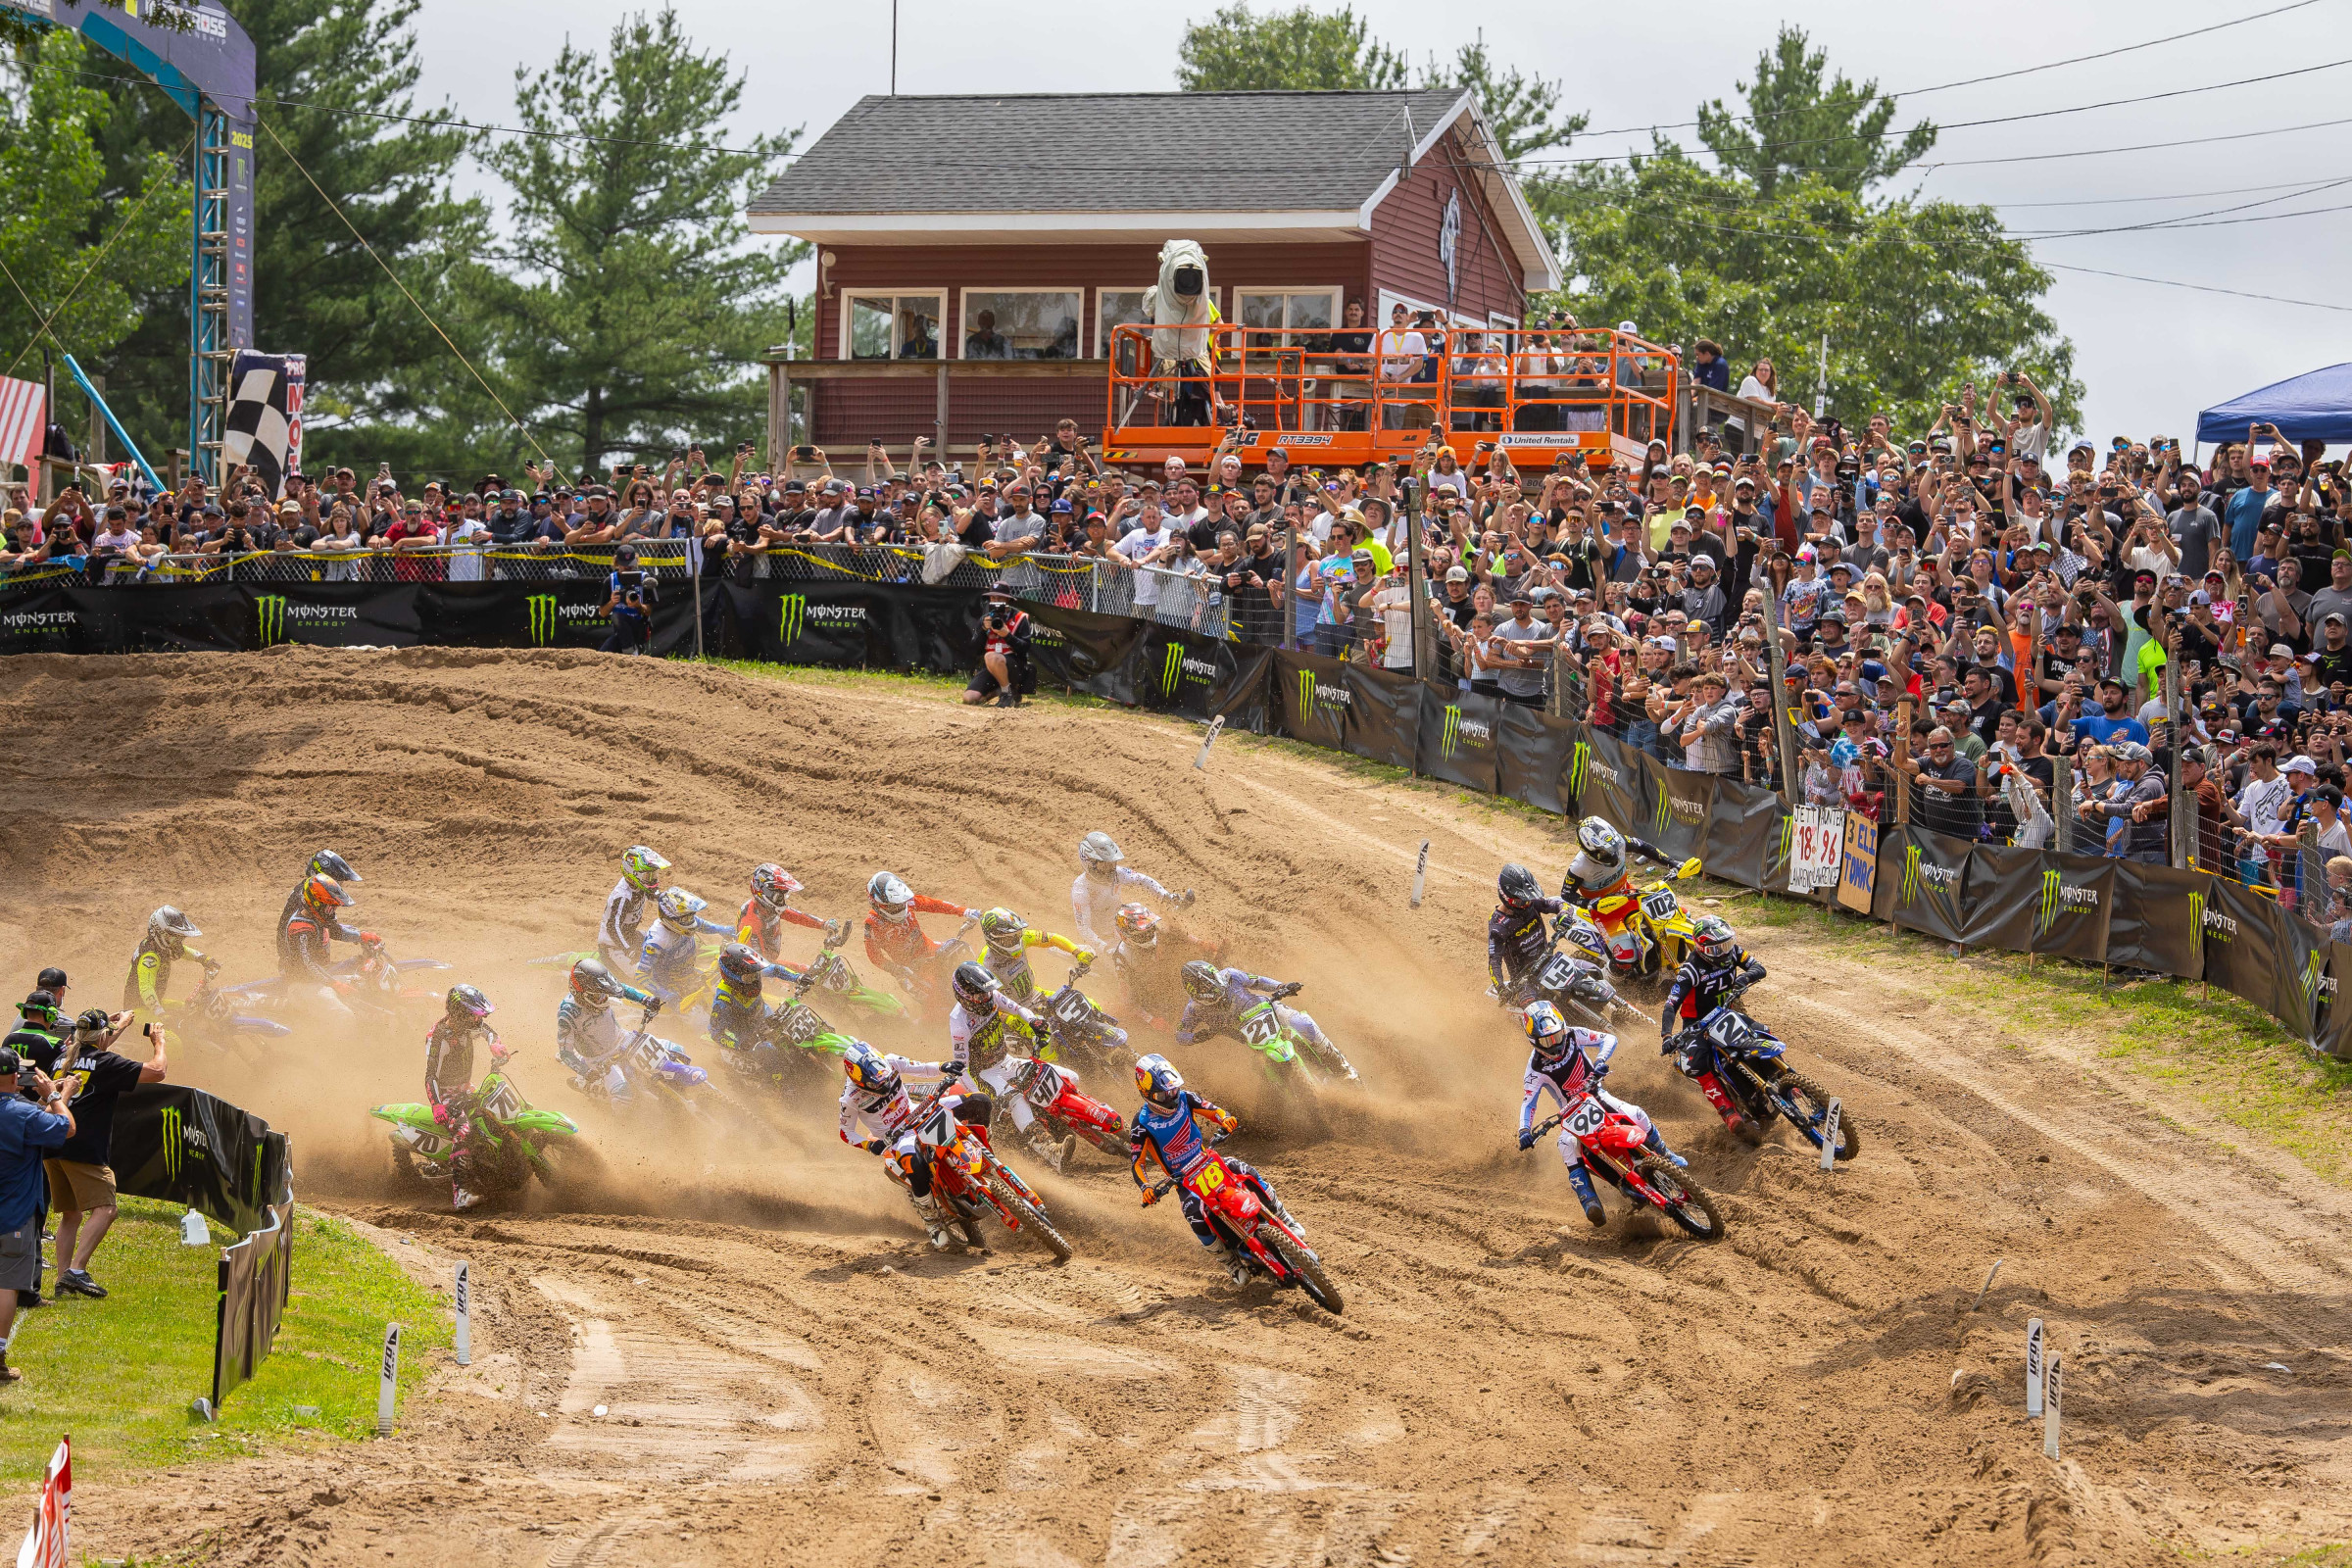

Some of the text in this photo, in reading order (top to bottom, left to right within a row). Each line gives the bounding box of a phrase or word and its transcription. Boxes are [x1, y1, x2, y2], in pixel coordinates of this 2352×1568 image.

[231, 131, 253, 149] 2025
[286, 361, 306, 376] PRO
[1238, 432, 1260, 445] LG
[1278, 435, 1333, 445] RT3394
[3, 612, 76, 627] MONSTER
[287, 604, 358, 618] MONSTER
[559, 603, 605, 618] MONS
[807, 604, 866, 619] MONSTER
[1182, 657, 1216, 678] MONSTER
[1186, 674, 1211, 685] ENERGY
[1315, 683, 1351, 704] MONSTER
[1320, 702, 1345, 711] ENERGY
[1458, 720, 1490, 741] MONSTER
[1462, 738, 1485, 749] ENERGY
[1589, 759, 1618, 784] MONSTER
[1593, 777, 1614, 791] ENERGY
[1669, 795, 1705, 816] MONSTER
[1793, 805, 1817, 823] JETT
[1677, 813, 1700, 824] ENERGY
[1799, 826, 1813, 860] 18
[1820, 830, 1838, 865] 96
[1847, 819, 1877, 856] 3 ELI
[1843, 852, 1874, 893] TOMAC
[1919, 861, 1954, 884] MONSTER
[2059, 883, 2098, 905] MONSTER
[1646, 893, 1676, 920] 102
[2063, 905, 2092, 914] ENERGY
[1567, 929, 1591, 947] 102
[2207, 929, 2231, 943] NERGY
[1544, 957, 1574, 987] 42
[1703, 968, 1737, 995] FLY
[1059, 992, 1090, 1020] 3
[787, 1008, 818, 1045] 535
[1247, 1013, 1277, 1045] 21
[1717, 1012, 1747, 1046] 2
[52, 1056, 97, 1071] DEAN
[633, 1035, 666, 1071] 444
[1032, 1068, 1059, 1105] 417
[489, 1088, 516, 1120] 70
[1770, 1094, 1795, 1117] DUNLOP
[924, 1108, 948, 1146] 7
[1574, 1103, 1604, 1137] 96
[1826, 1114, 1835, 1144] UFO
[413, 1129, 440, 1155] 70
[1166, 1137, 1201, 1160] HONDA
[1196, 1161, 1225, 1198] 18
[1635, 1183, 1661, 1204] DUNLOP
[383, 1346, 393, 1381] UFO
